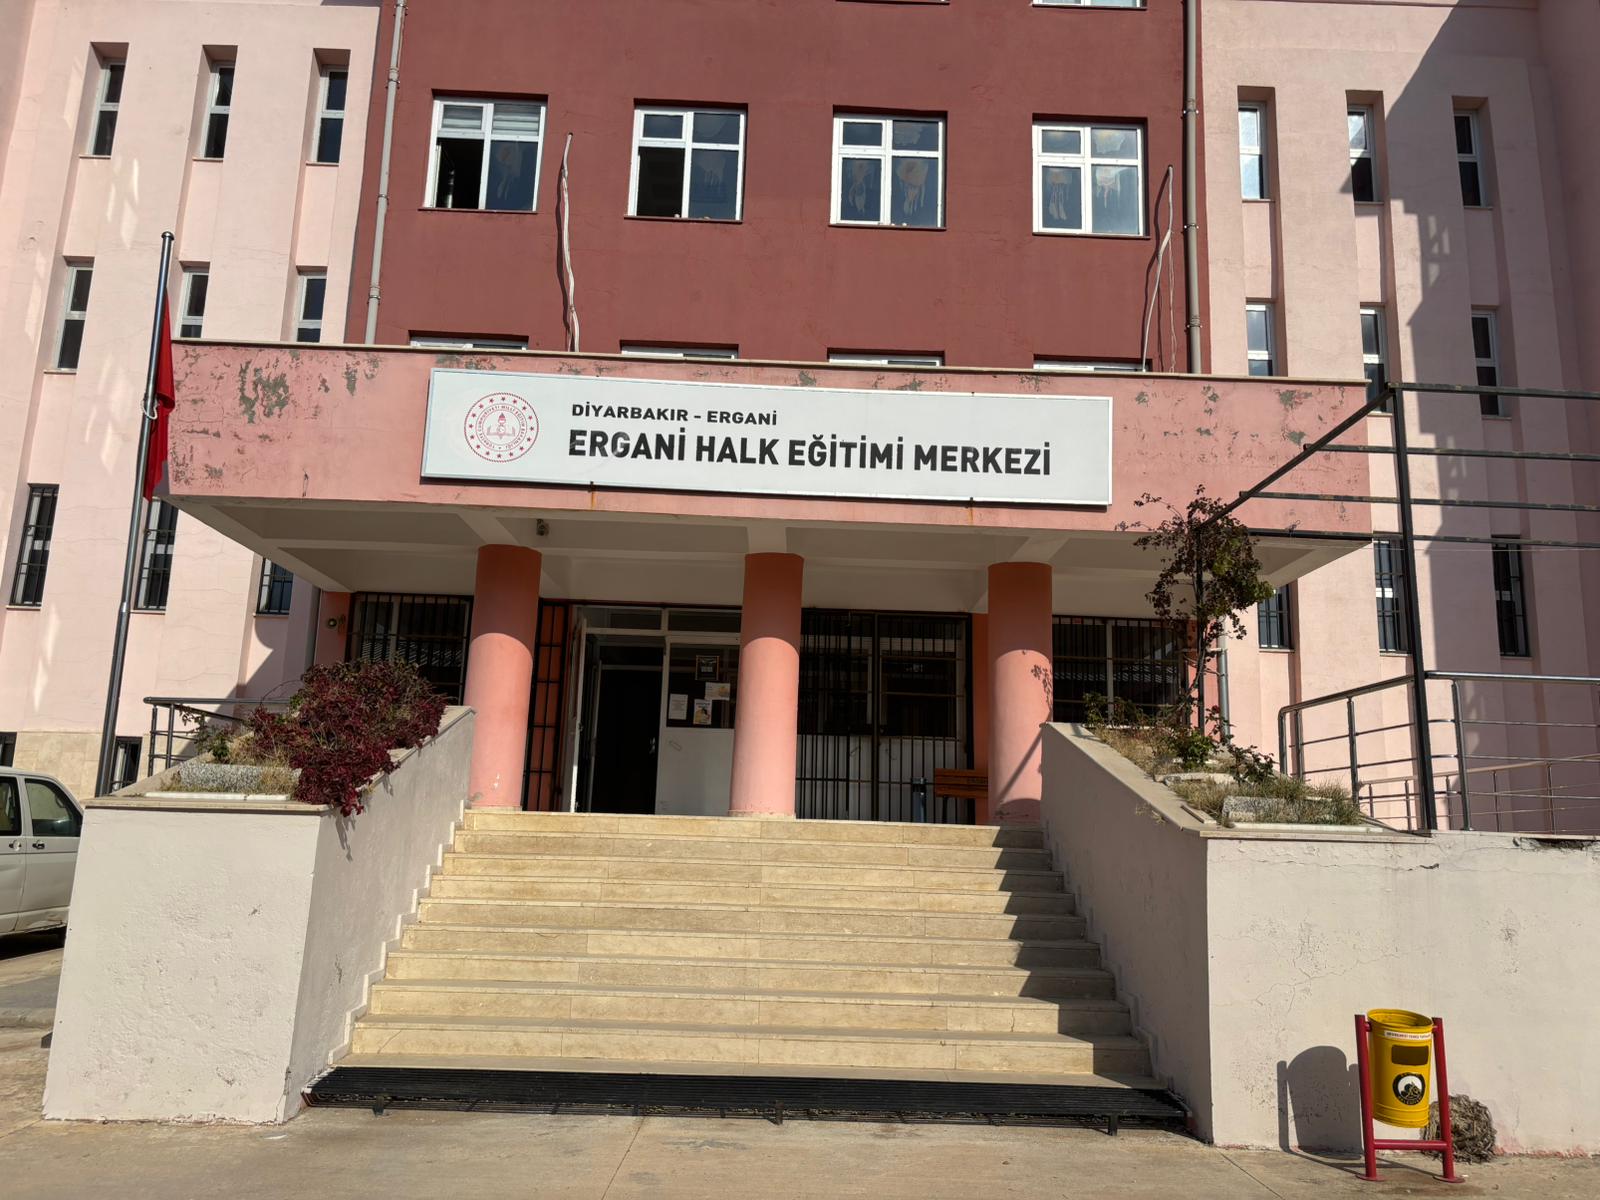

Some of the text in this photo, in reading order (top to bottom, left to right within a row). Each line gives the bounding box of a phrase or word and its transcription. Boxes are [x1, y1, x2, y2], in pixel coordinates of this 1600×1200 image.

[572, 401, 689, 422] DİYARBAKIR
[707, 409, 777, 426] ERGANİ
[568, 427, 686, 461] ERGANİ
[695, 435, 780, 465] HALK
[788, 433, 904, 470] EĞİTİMİ
[914, 441, 1050, 476] MERKEZİ
